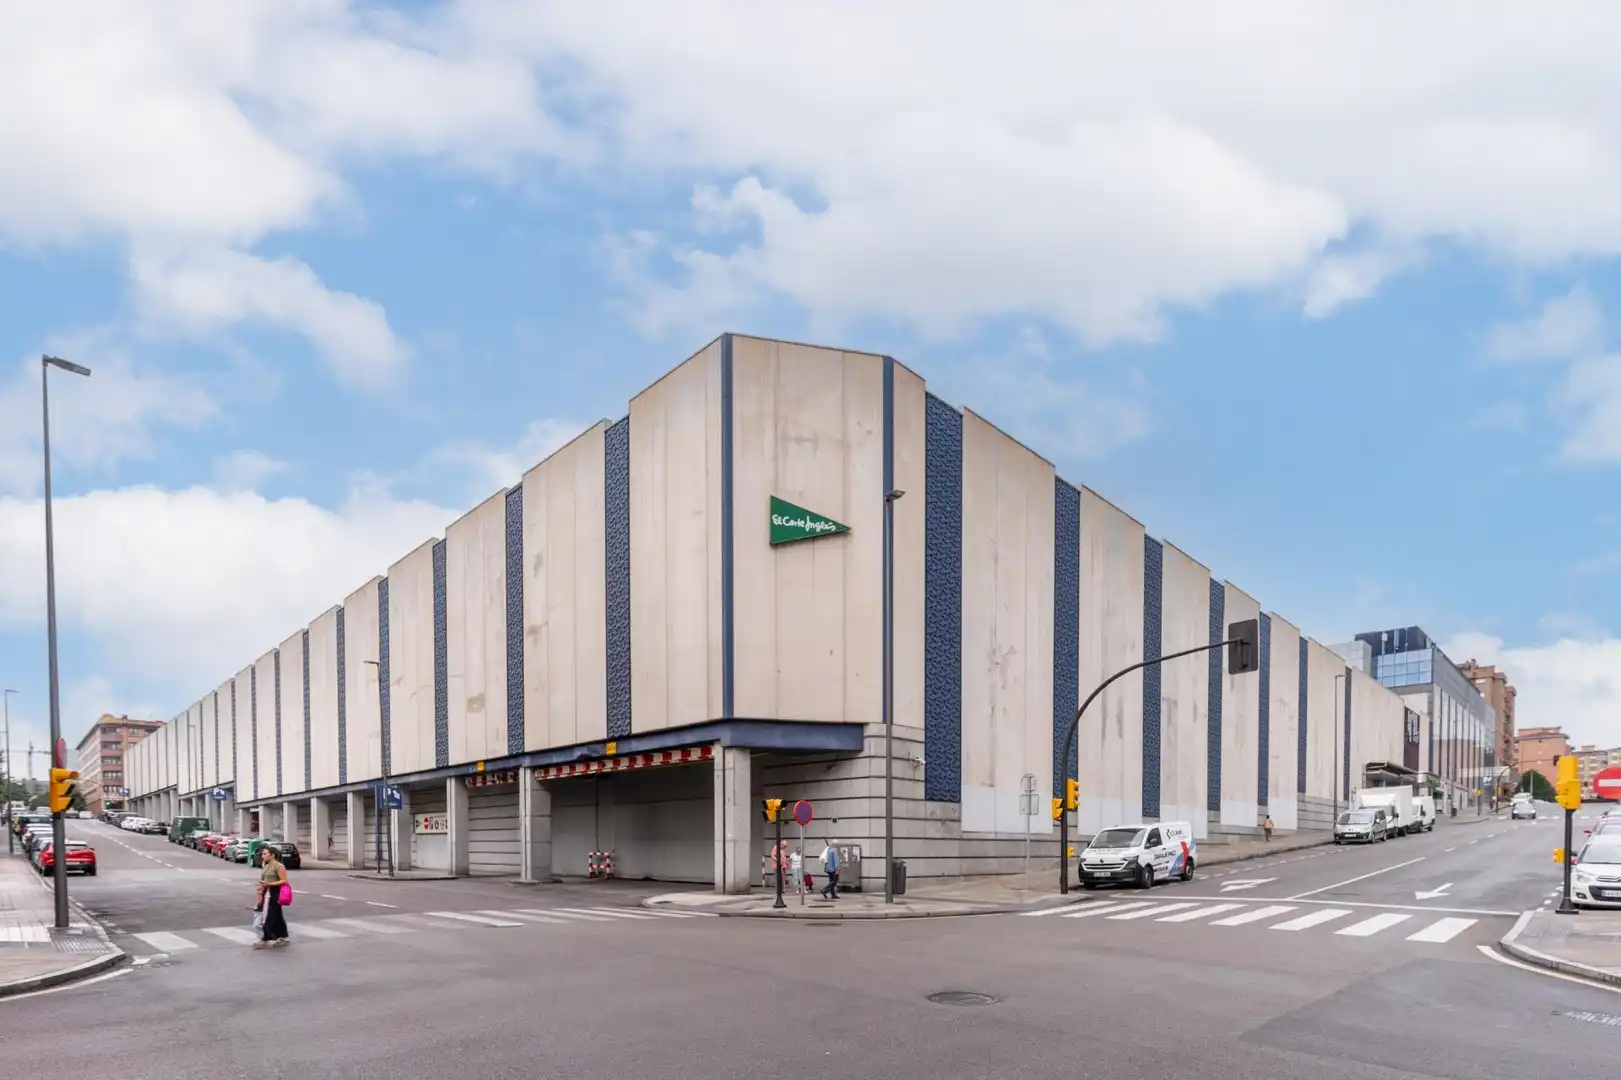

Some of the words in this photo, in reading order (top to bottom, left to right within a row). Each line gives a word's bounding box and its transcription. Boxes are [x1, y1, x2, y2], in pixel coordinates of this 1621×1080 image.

[772, 514, 782, 525] El
[782, 516, 805, 528] Corte
[383, 787, 391, 800] P
